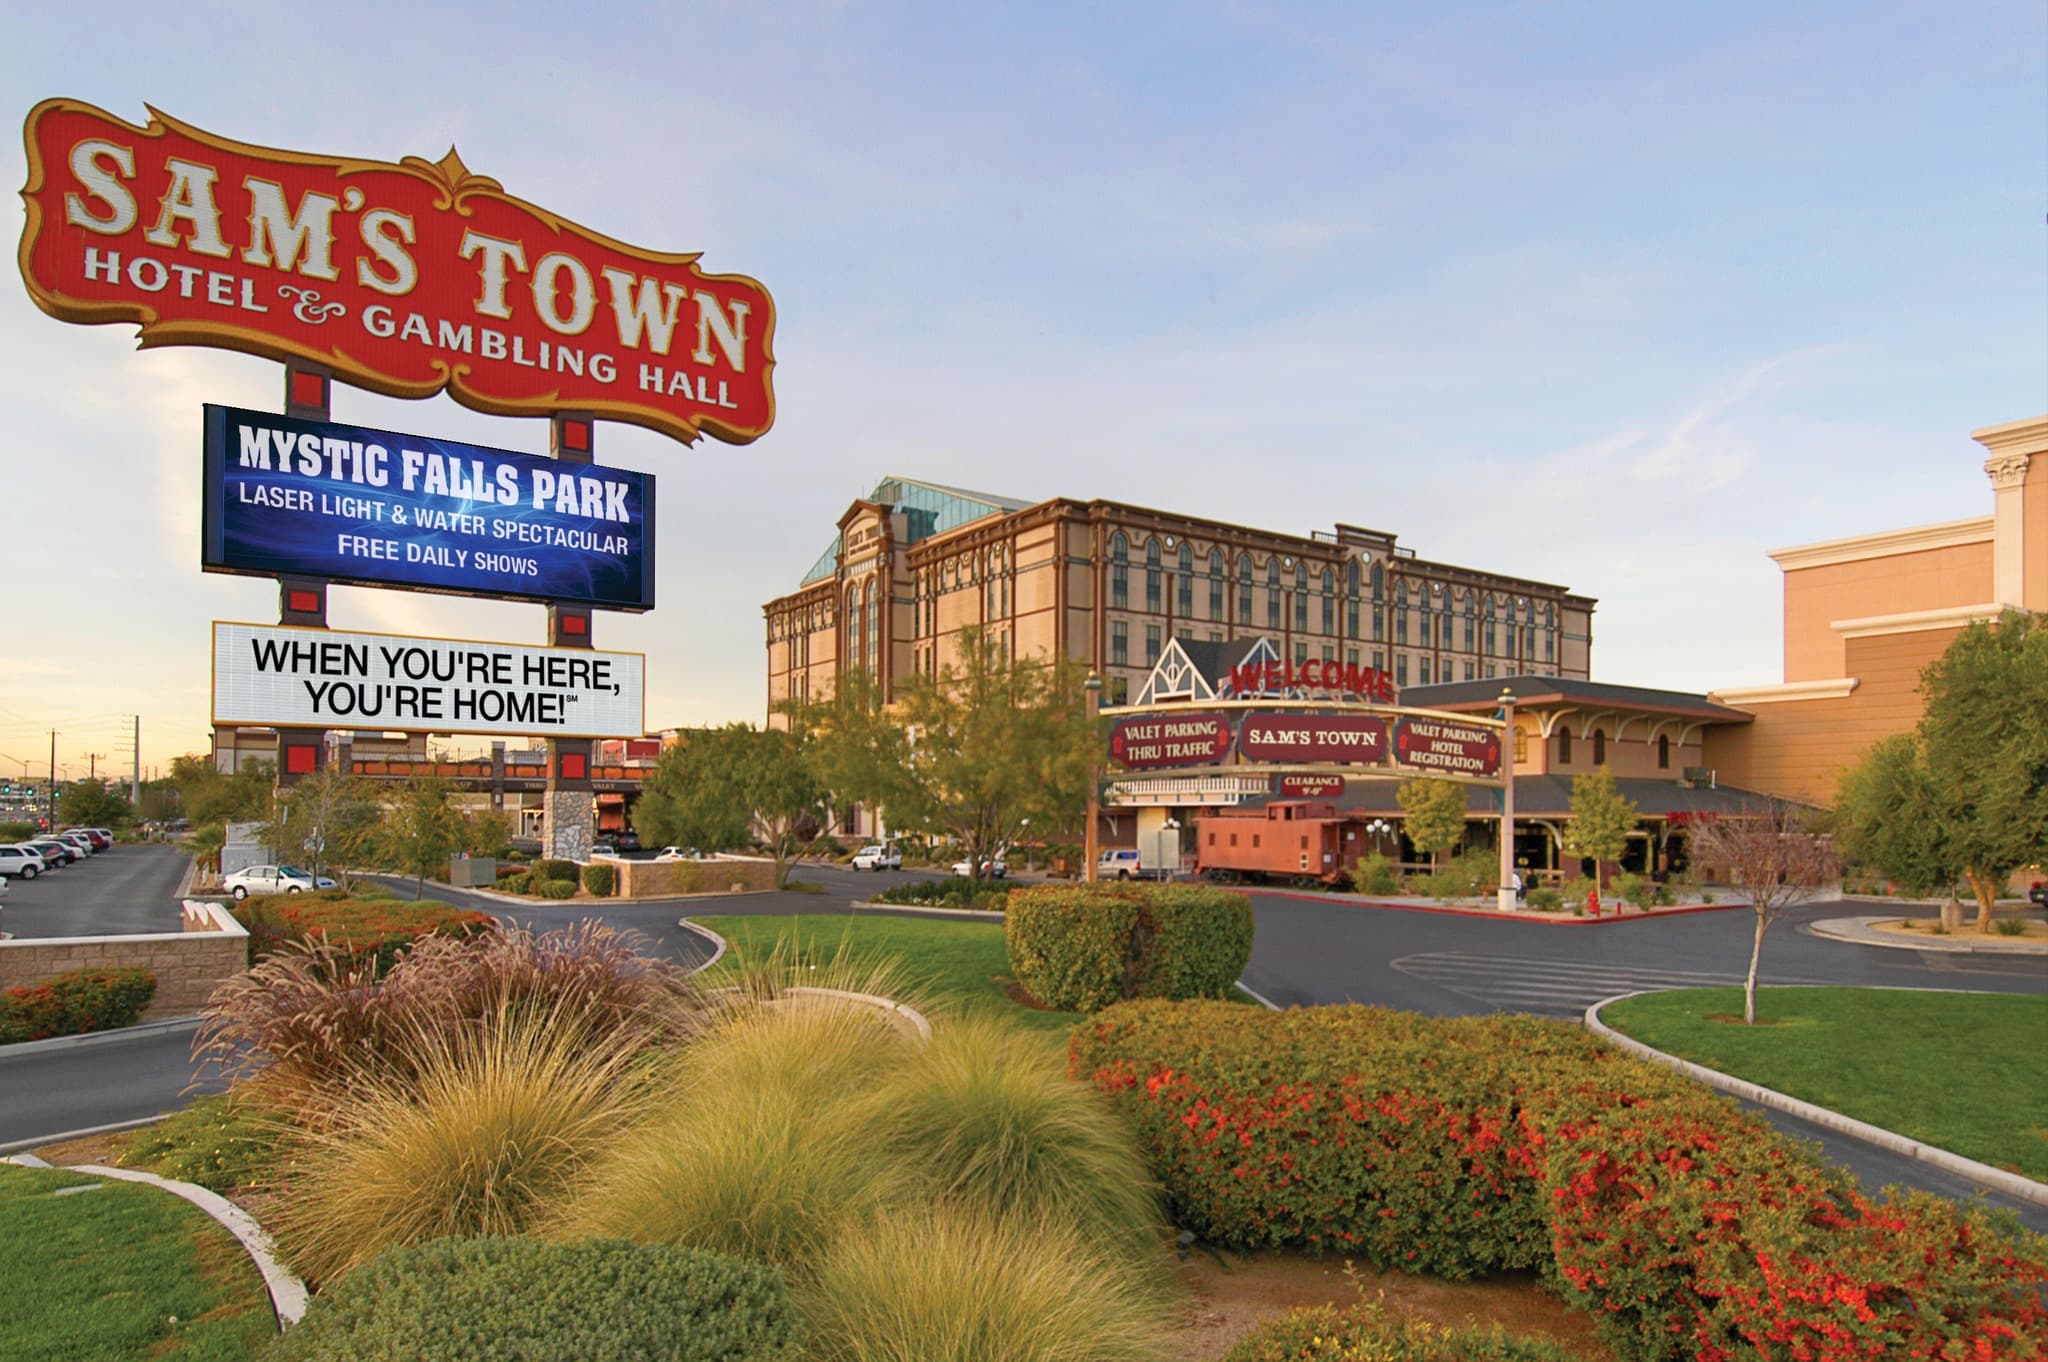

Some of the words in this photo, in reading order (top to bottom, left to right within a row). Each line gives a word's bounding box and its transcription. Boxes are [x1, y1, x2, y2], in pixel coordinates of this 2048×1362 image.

[64, 138, 419, 297] SAM'S
[458, 226, 752, 374] TOWN
[83, 247, 269, 313] HOTEL
[277, 285, 347, 324] &
[361, 304, 617, 384] GAMBLING
[639, 363, 738, 409] HALL
[238, 424, 389, 487] MYSTIC
[401, 449, 520, 506] FALLS
[532, 468, 631, 523] PARK
[239, 481, 314, 512] LASER
[321, 493, 386, 522] LIGHT
[391, 504, 408, 525] &
[414, 507, 486, 536] WATER
[493, 518, 629, 555] SPECTACULAR
[338, 533, 400, 561] FREE
[407, 543, 468, 568] DAILY
[474, 551, 538, 577] SHOWS
[251, 638, 368, 677] WHEN
[380, 646, 512, 684] YOU'RE
[523, 655, 620, 697] HERE,
[1230, 659, 1394, 704] WELCOME
[303, 680, 443, 718] YOU'RE
[1125, 725, 1161, 740] VALET
[1165, 721, 1218, 738] PARKING
[1250, 729, 1311, 745] SAM'S
[1316, 731, 1378, 746] TOWN
[1410, 723, 1440, 738] VALET
[1442, 727, 1487, 744] PARKING
[1431, 741, 1464, 755] HOTEL
[1127, 745, 1161, 761] THRU
[1165, 741, 1215, 759] TRAFFIC
[1410, 751, 1484, 770] REGISTRATION
[1284, 776, 1339, 786] CLEARANCE
